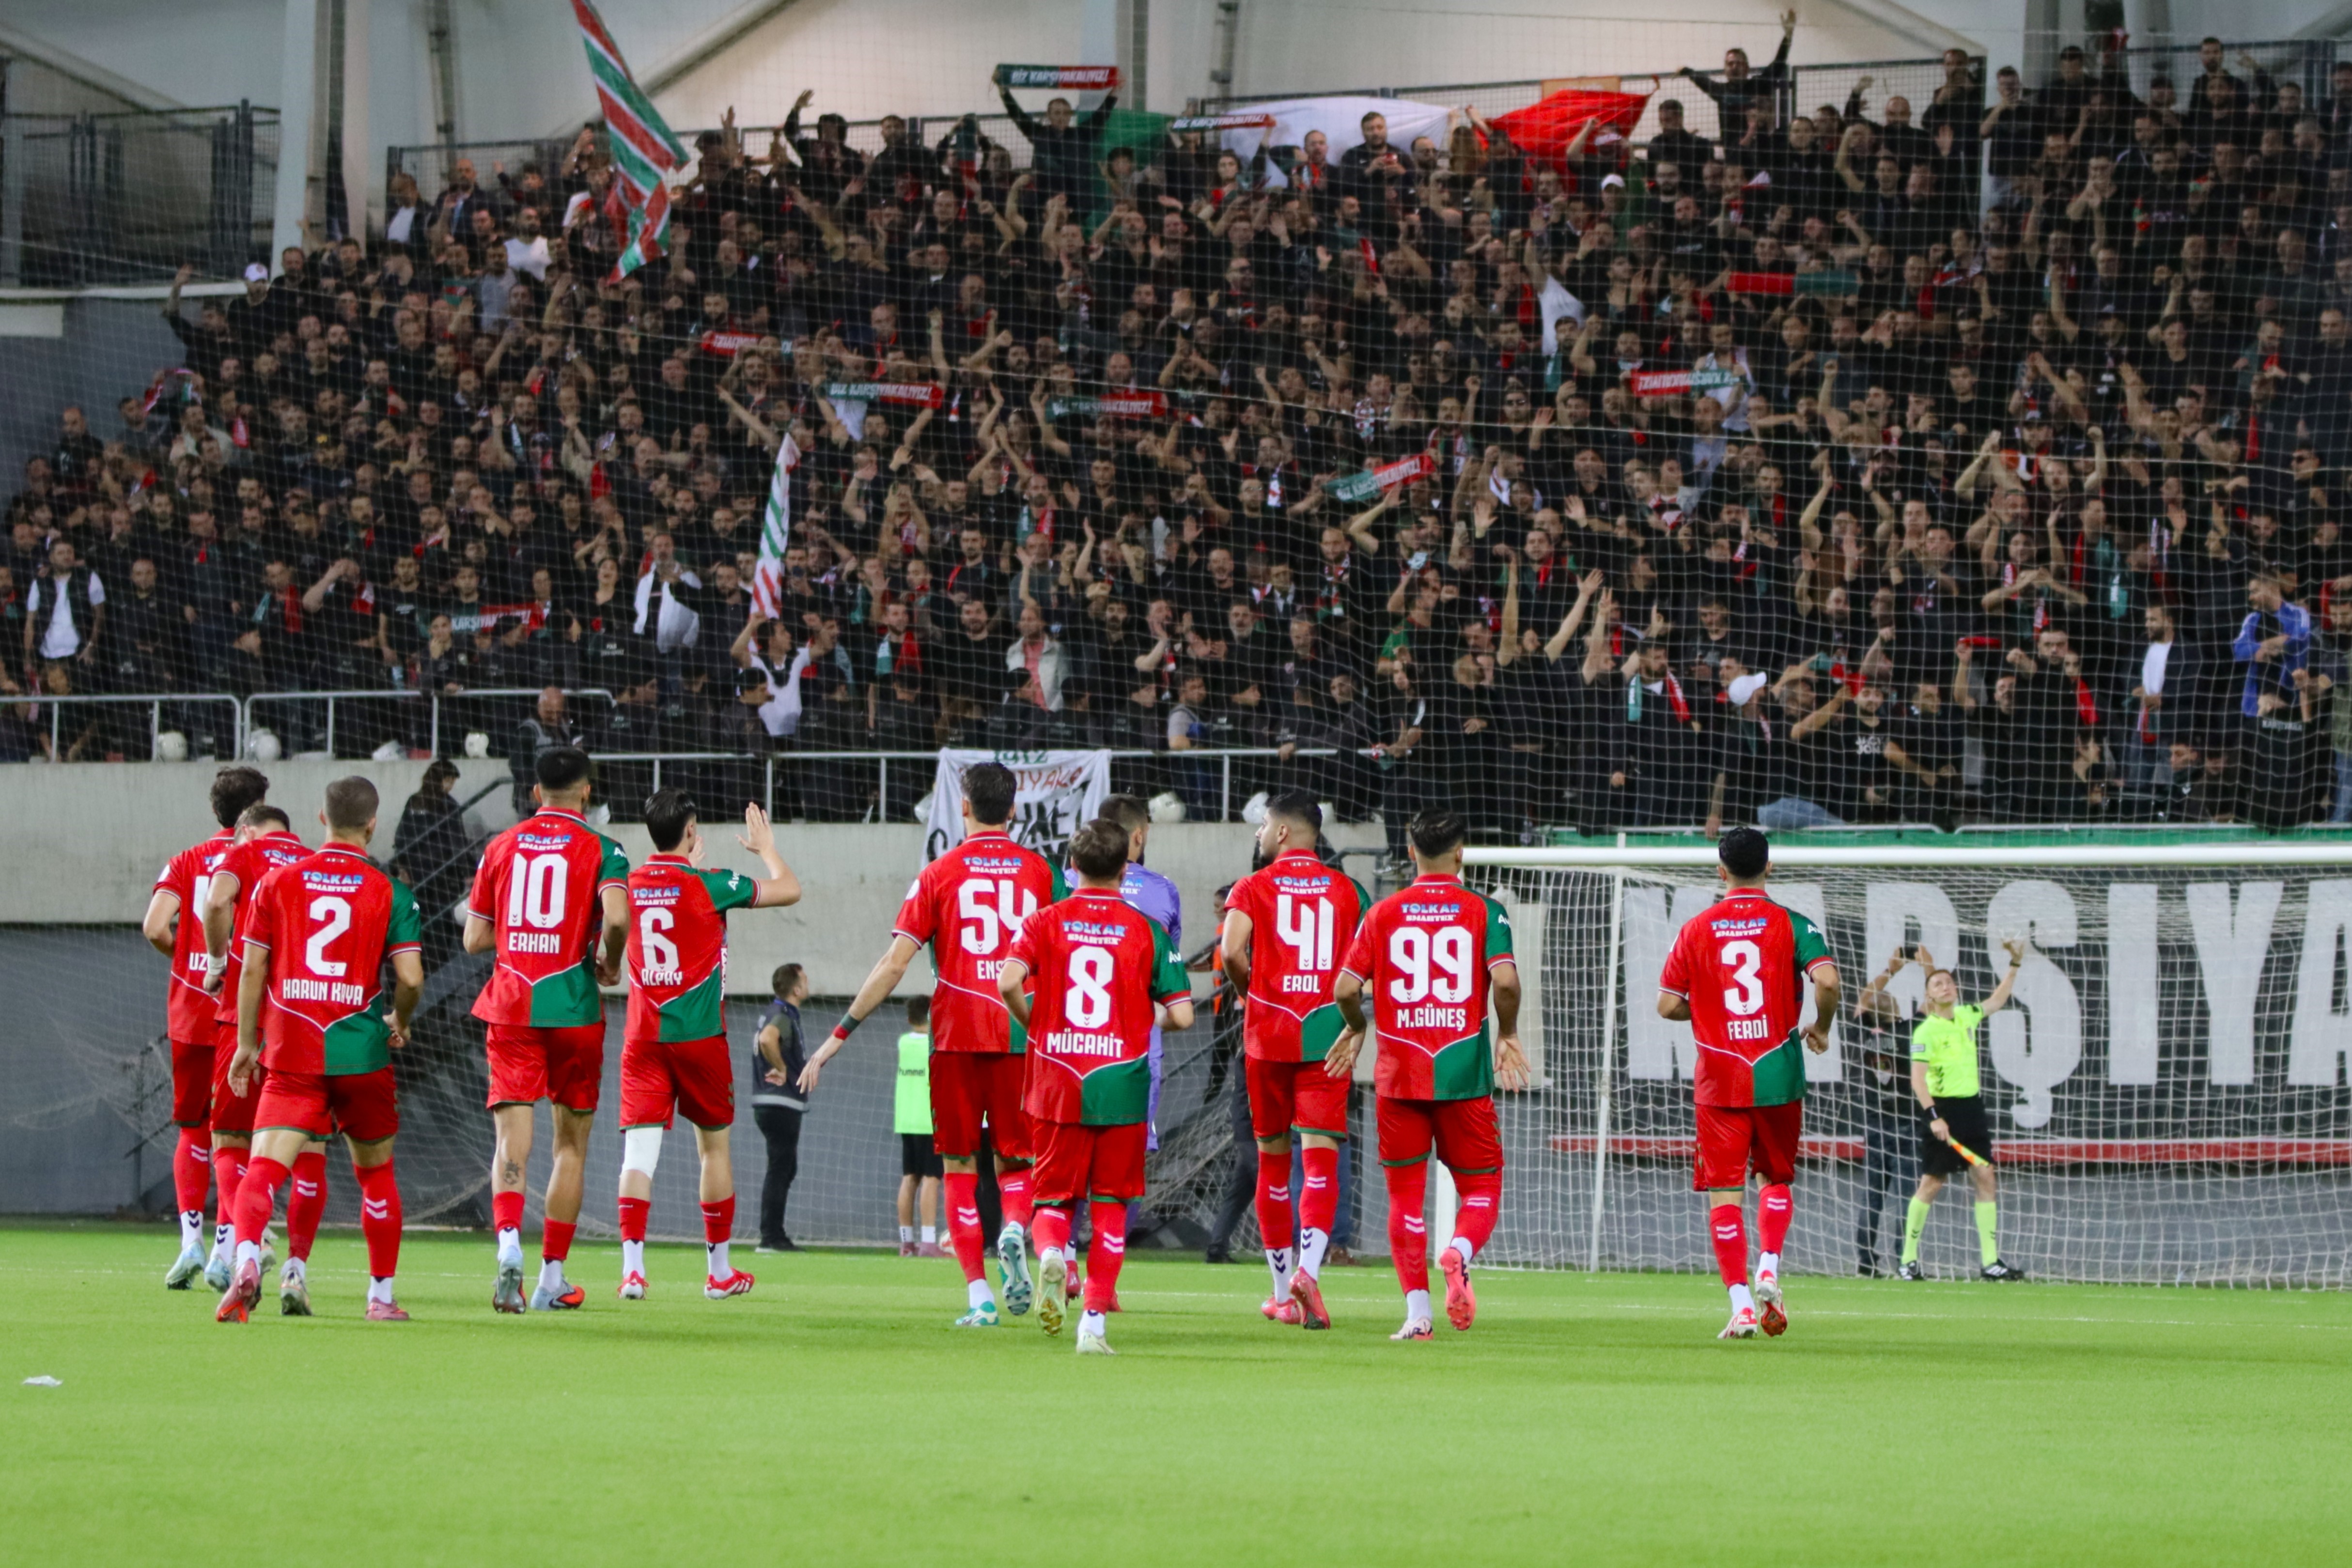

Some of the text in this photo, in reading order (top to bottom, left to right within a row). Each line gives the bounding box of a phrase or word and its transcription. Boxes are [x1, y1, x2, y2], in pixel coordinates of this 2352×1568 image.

[517, 833, 572, 843] TOLKAR
[963, 857, 1022, 868] TOLKAR
[302, 870, 363, 885] TOLKAR
[1274, 876, 1331, 887] TOLKAR
[508, 853, 568, 928] 10
[633, 887, 680, 898] TOLKAR
[958, 878, 1037, 955] 54
[1401, 903, 1460, 914] TOLKAR
[1062, 921, 1125, 937] TOLKAR
[1277, 895, 1334, 970] 41
[1711, 917, 1767, 931] TOLKAR
[305, 896, 351, 977] 2
[509, 932, 560, 954] ERHAN
[640, 907, 679, 972] 6
[1390, 926, 1473, 1003] 99
[641, 968, 683, 986] ALPAY
[1065, 945, 1114, 1028] 8
[1283, 975, 1321, 993] EROL
[1721, 940, 1764, 1015] 3
[283, 979, 363, 1006] HARUN KAYA
[1397, 1003, 1466, 1032] M.GÜNEŞ
[1727, 1014, 1769, 1040] FERDİ
[1047, 1027, 1124, 1058] MÜCAHİT
[899, 1067, 926, 1076] hummel
